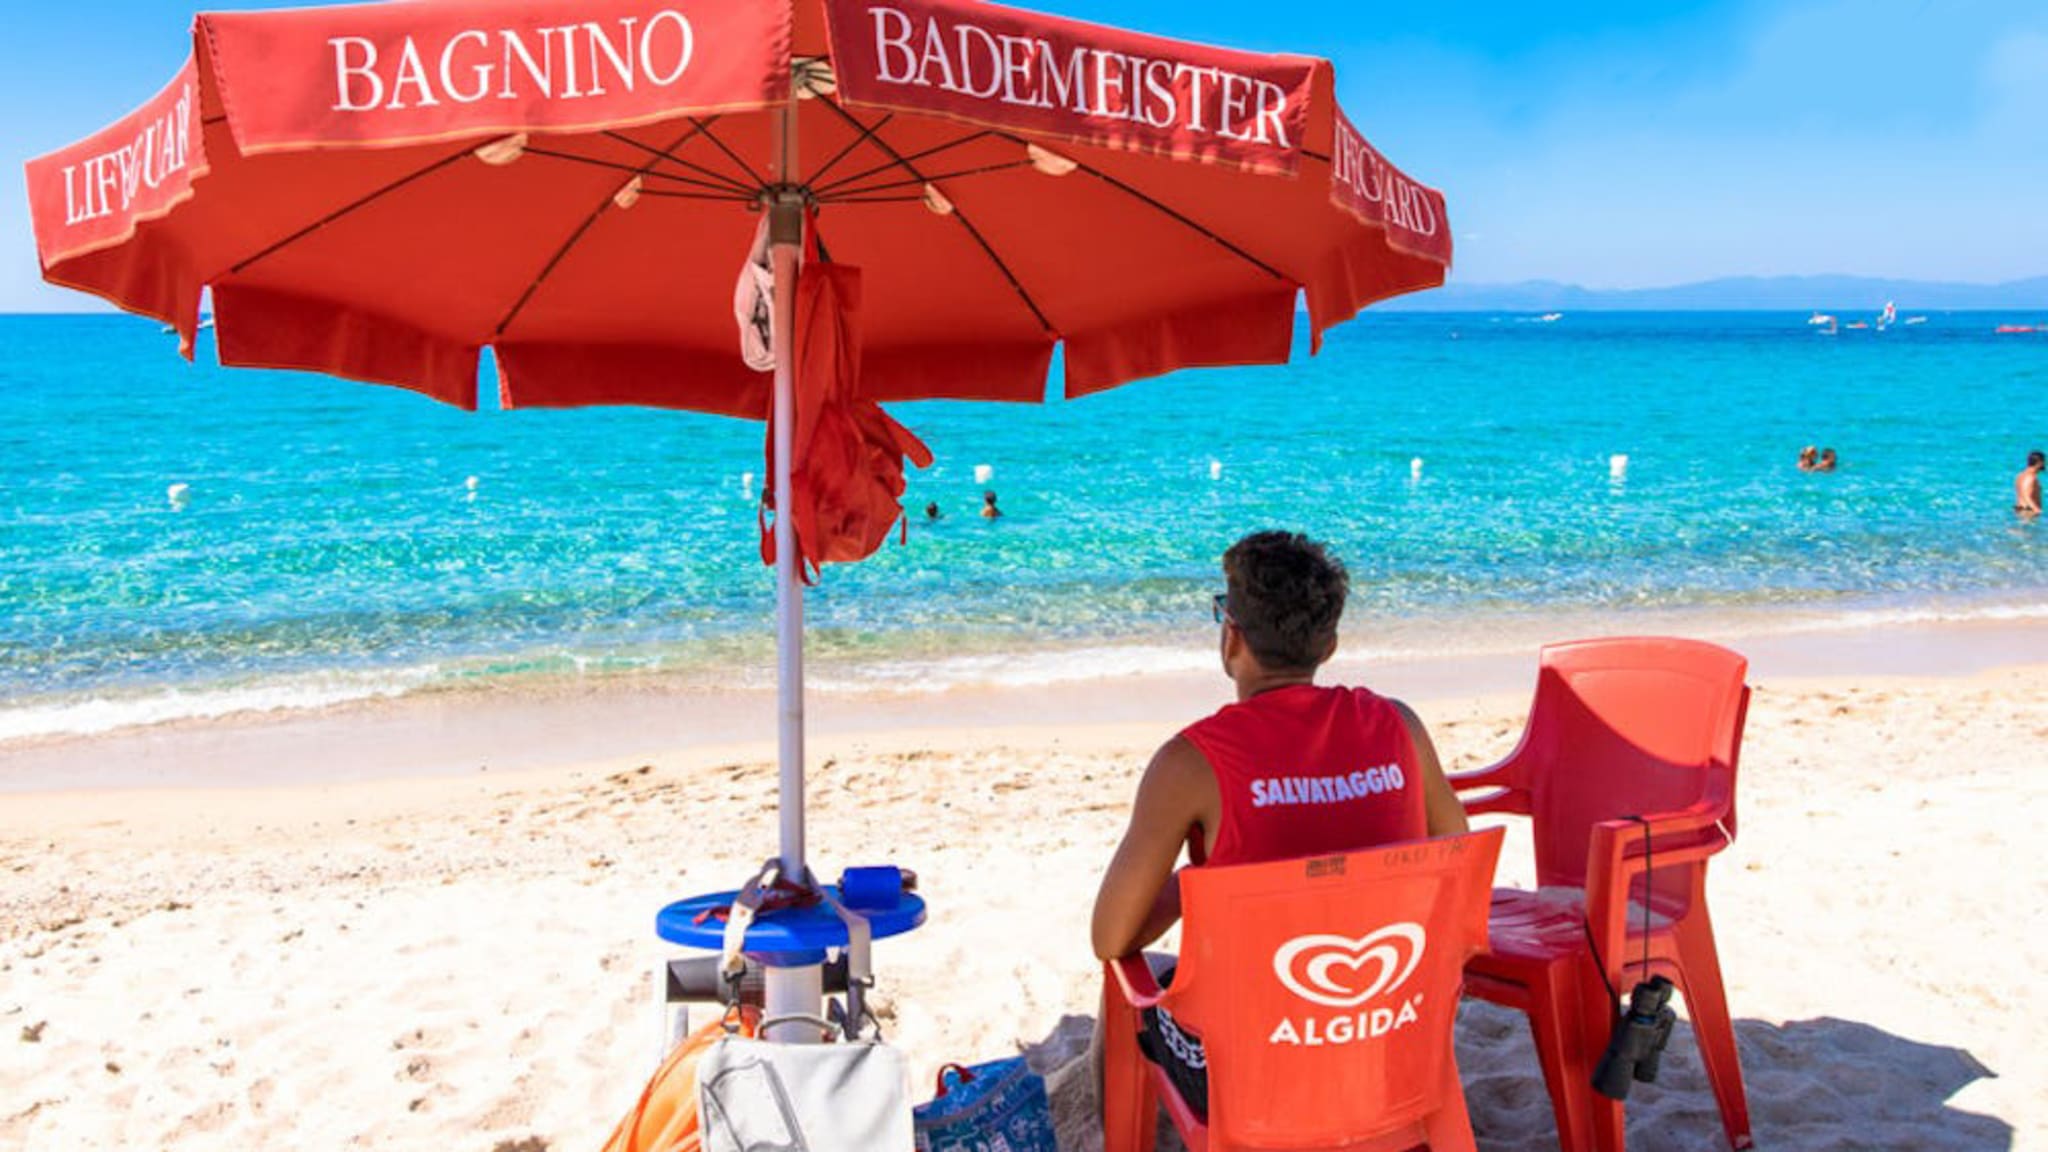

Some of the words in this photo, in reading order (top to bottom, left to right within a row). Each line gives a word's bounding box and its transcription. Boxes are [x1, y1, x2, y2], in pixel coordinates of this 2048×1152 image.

[328, 9, 694, 112] BAGNINO
[868, 7, 1292, 148] BADEMEISTER
[62, 82, 192, 227] LIFEGUAR
[1250, 763, 1405, 808] SALVATAGGIO
[1269, 998, 1419, 1046] ALGIDA
